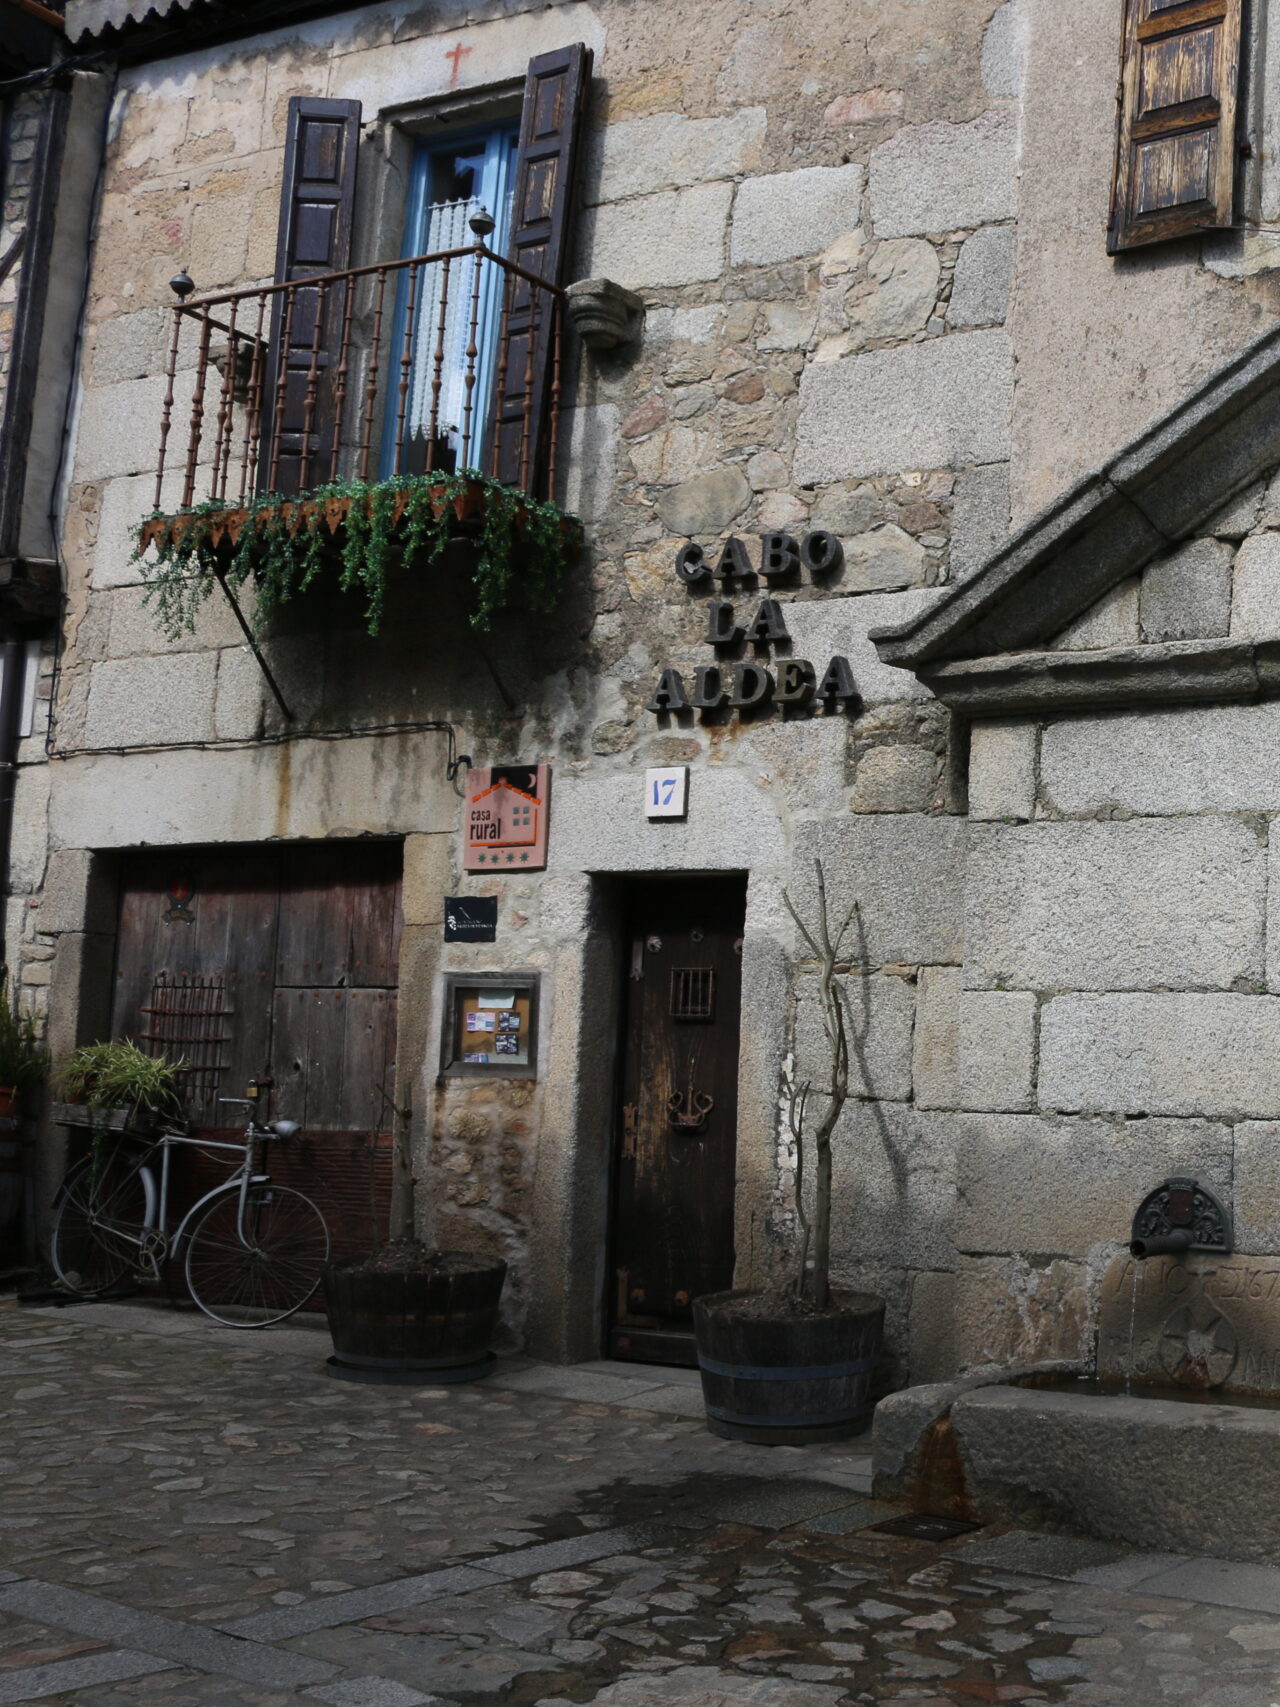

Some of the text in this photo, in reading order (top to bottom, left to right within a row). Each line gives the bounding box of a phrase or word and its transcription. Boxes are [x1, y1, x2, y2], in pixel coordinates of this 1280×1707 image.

[675, 530, 845, 583] CABO
[704, 599, 793, 645] LA
[646, 655, 864, 713] ALDEA
[652, 778, 677, 806] 17
[470, 818, 501, 840] rural
[471, 809, 491, 822] casa
